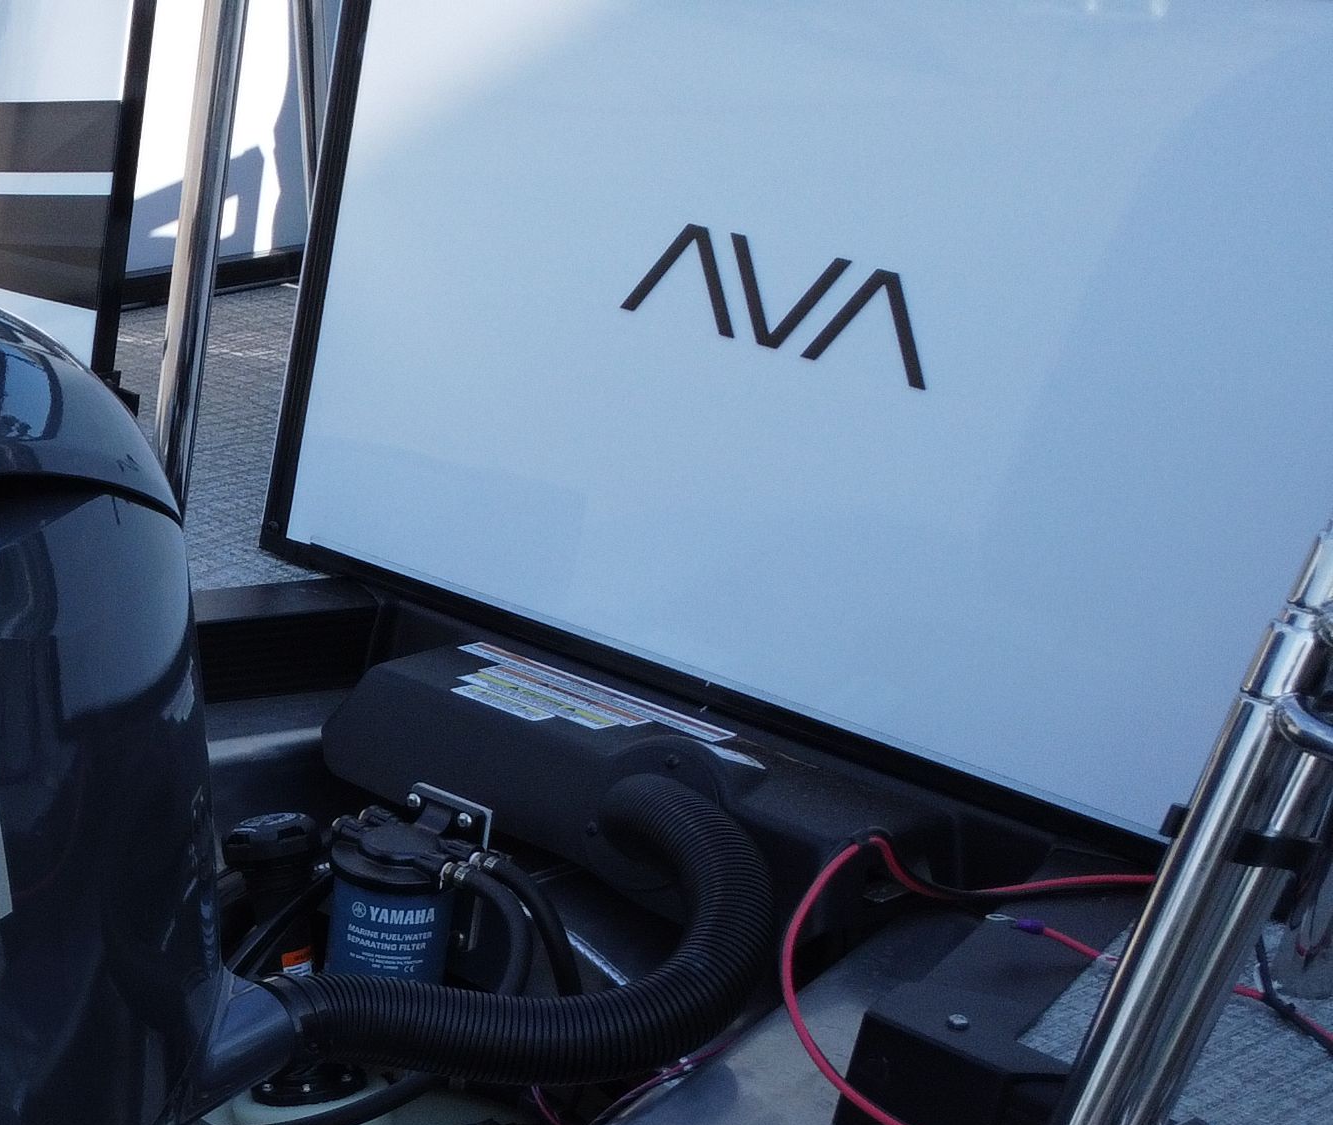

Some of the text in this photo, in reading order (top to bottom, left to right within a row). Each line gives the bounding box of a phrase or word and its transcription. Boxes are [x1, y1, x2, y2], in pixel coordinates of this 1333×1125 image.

[620, 223, 926, 390] AVA
[369, 905, 435, 925] YAMAHA
[347, 924, 433, 941] MARINE FUEL/WATER
[347, 933, 427, 951] SEPARATING FILTER
